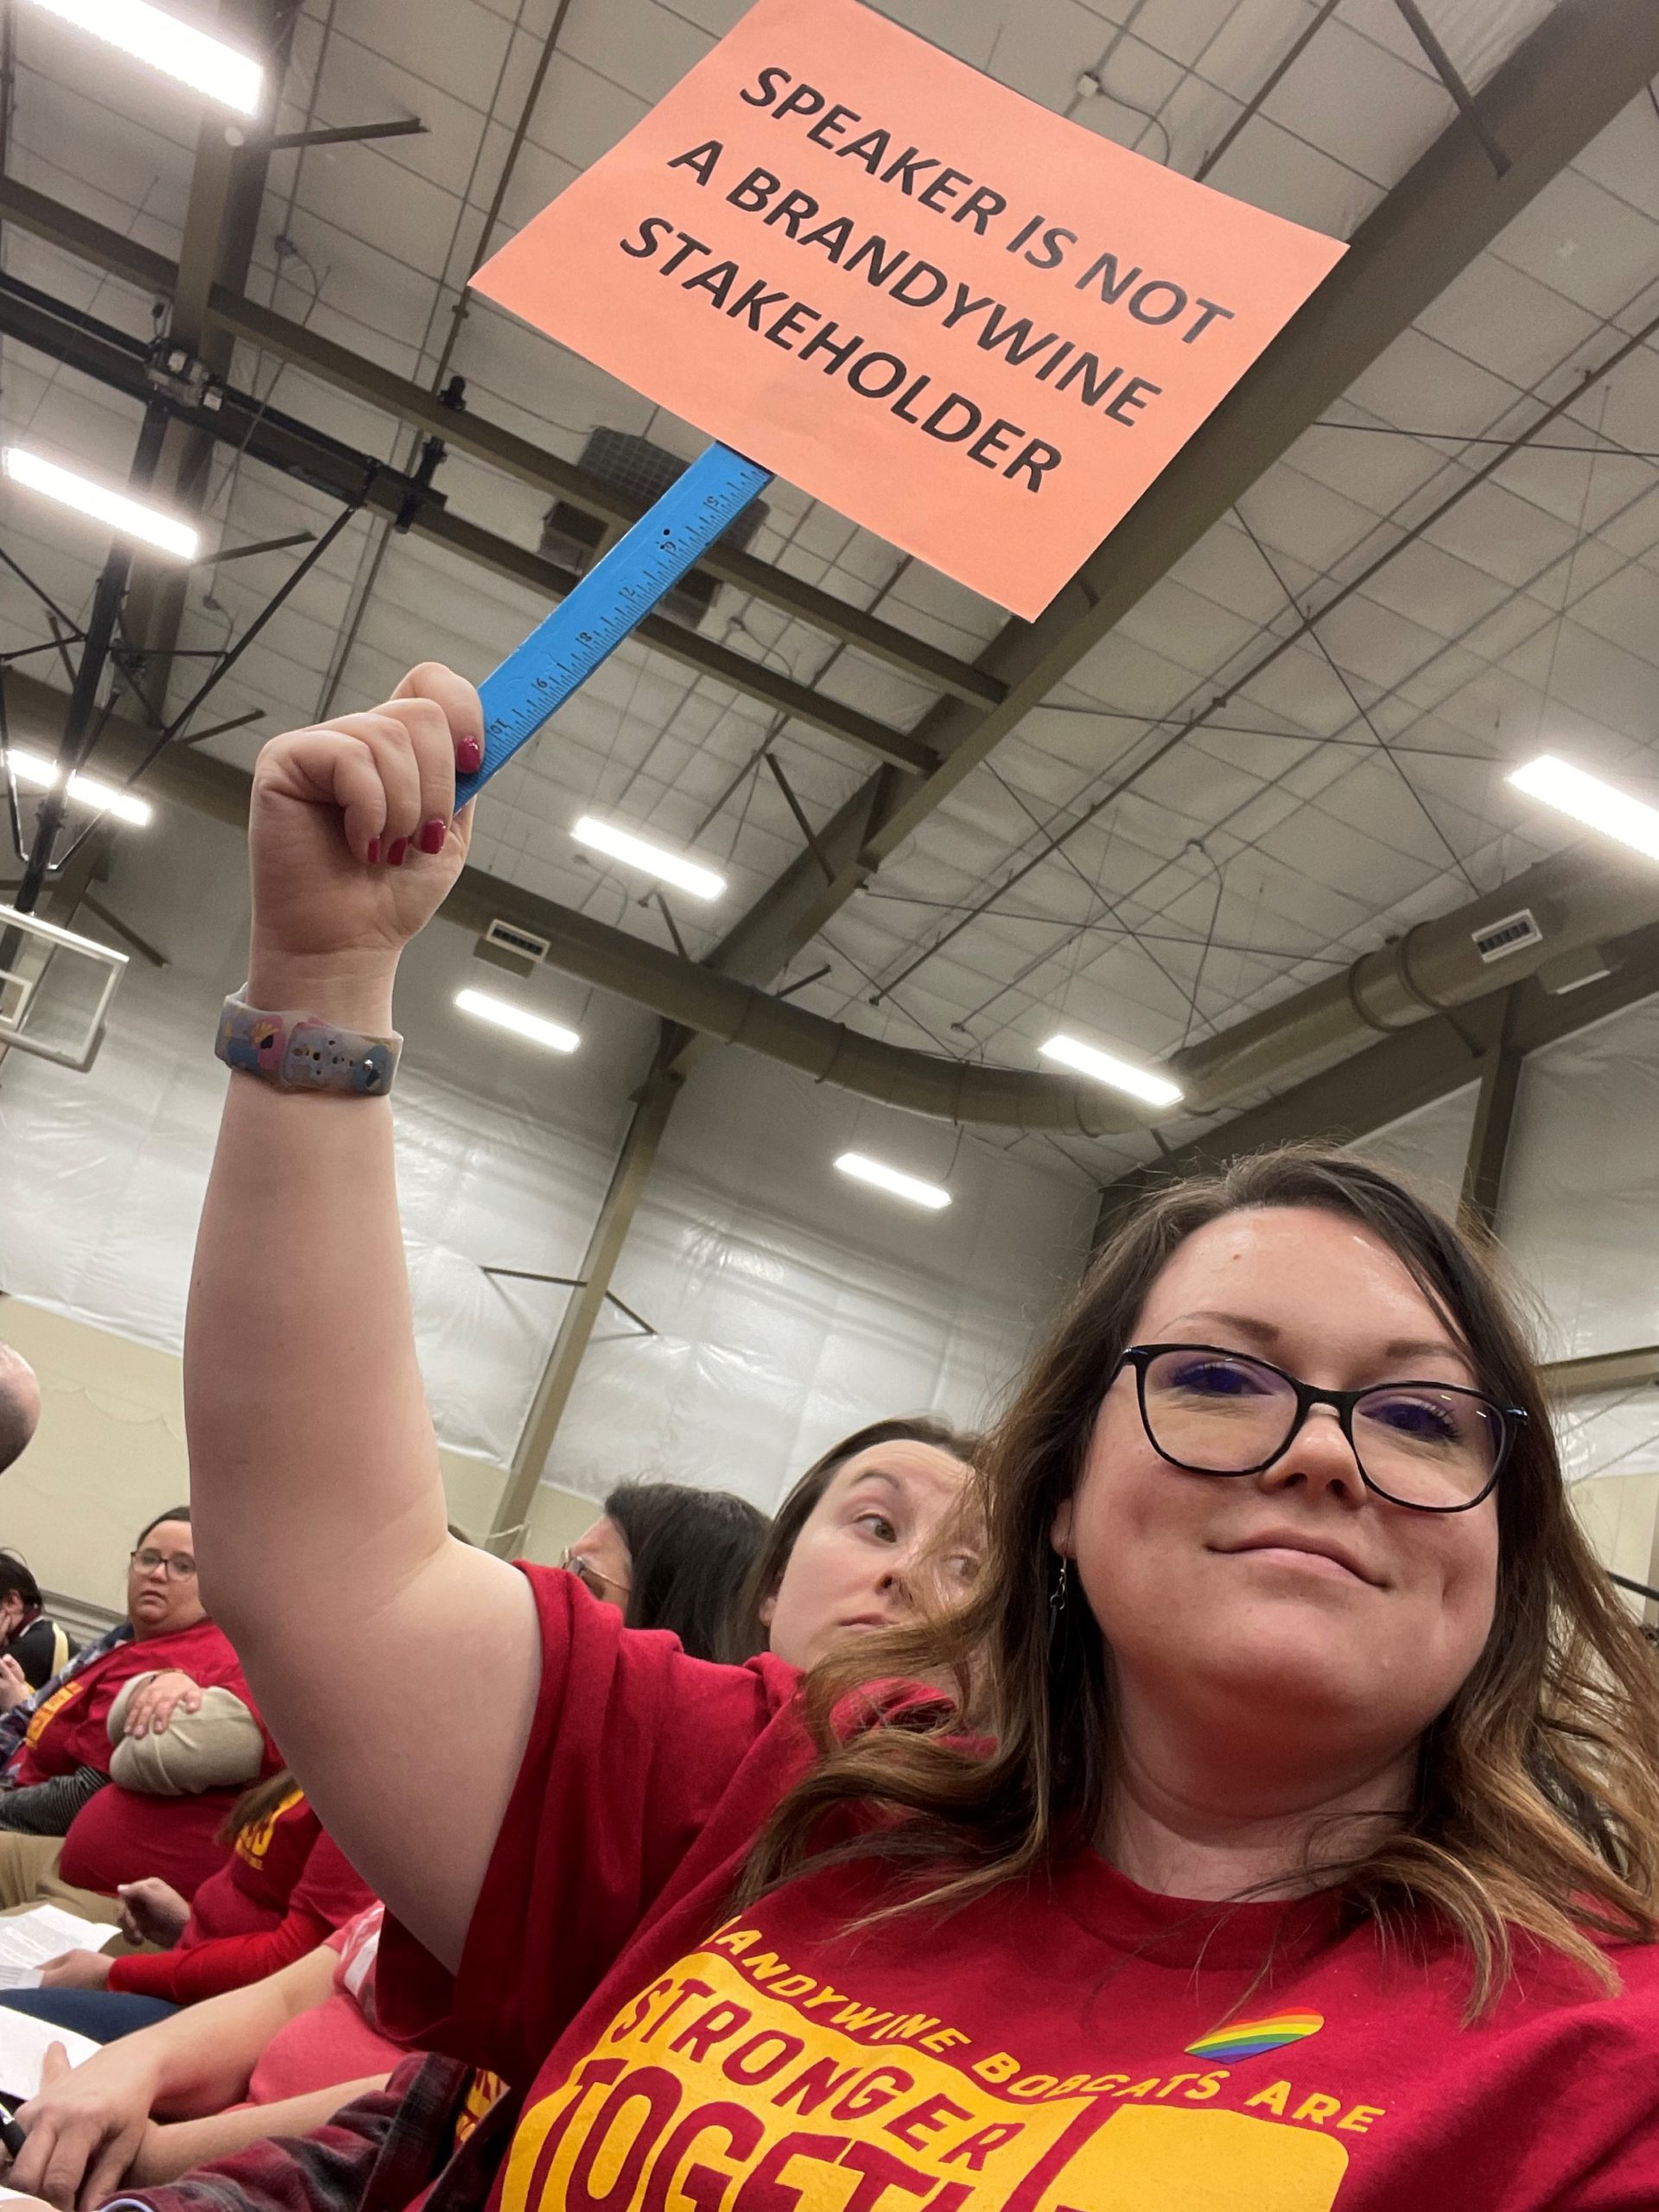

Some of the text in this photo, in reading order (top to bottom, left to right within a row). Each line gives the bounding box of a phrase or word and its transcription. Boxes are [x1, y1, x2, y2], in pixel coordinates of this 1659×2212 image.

[666, 139, 1163, 427] A BRANDYWINE
[740, 67, 1235, 344] SPEAKER IS NOT
[619, 217, 1062, 493] STAKEHOLDER
[706, 495, 720, 507] 5
[536, 677, 548, 689] 9
[579, 632, 592, 642] 8
[490, 718, 509, 734] 10
[610, 1978, 1026, 2171] STRONGER
[701, 1914, 1386, 2133] ANDYWINE BOBCATS ARE
[524, 2057, 976, 2212] TOGET
